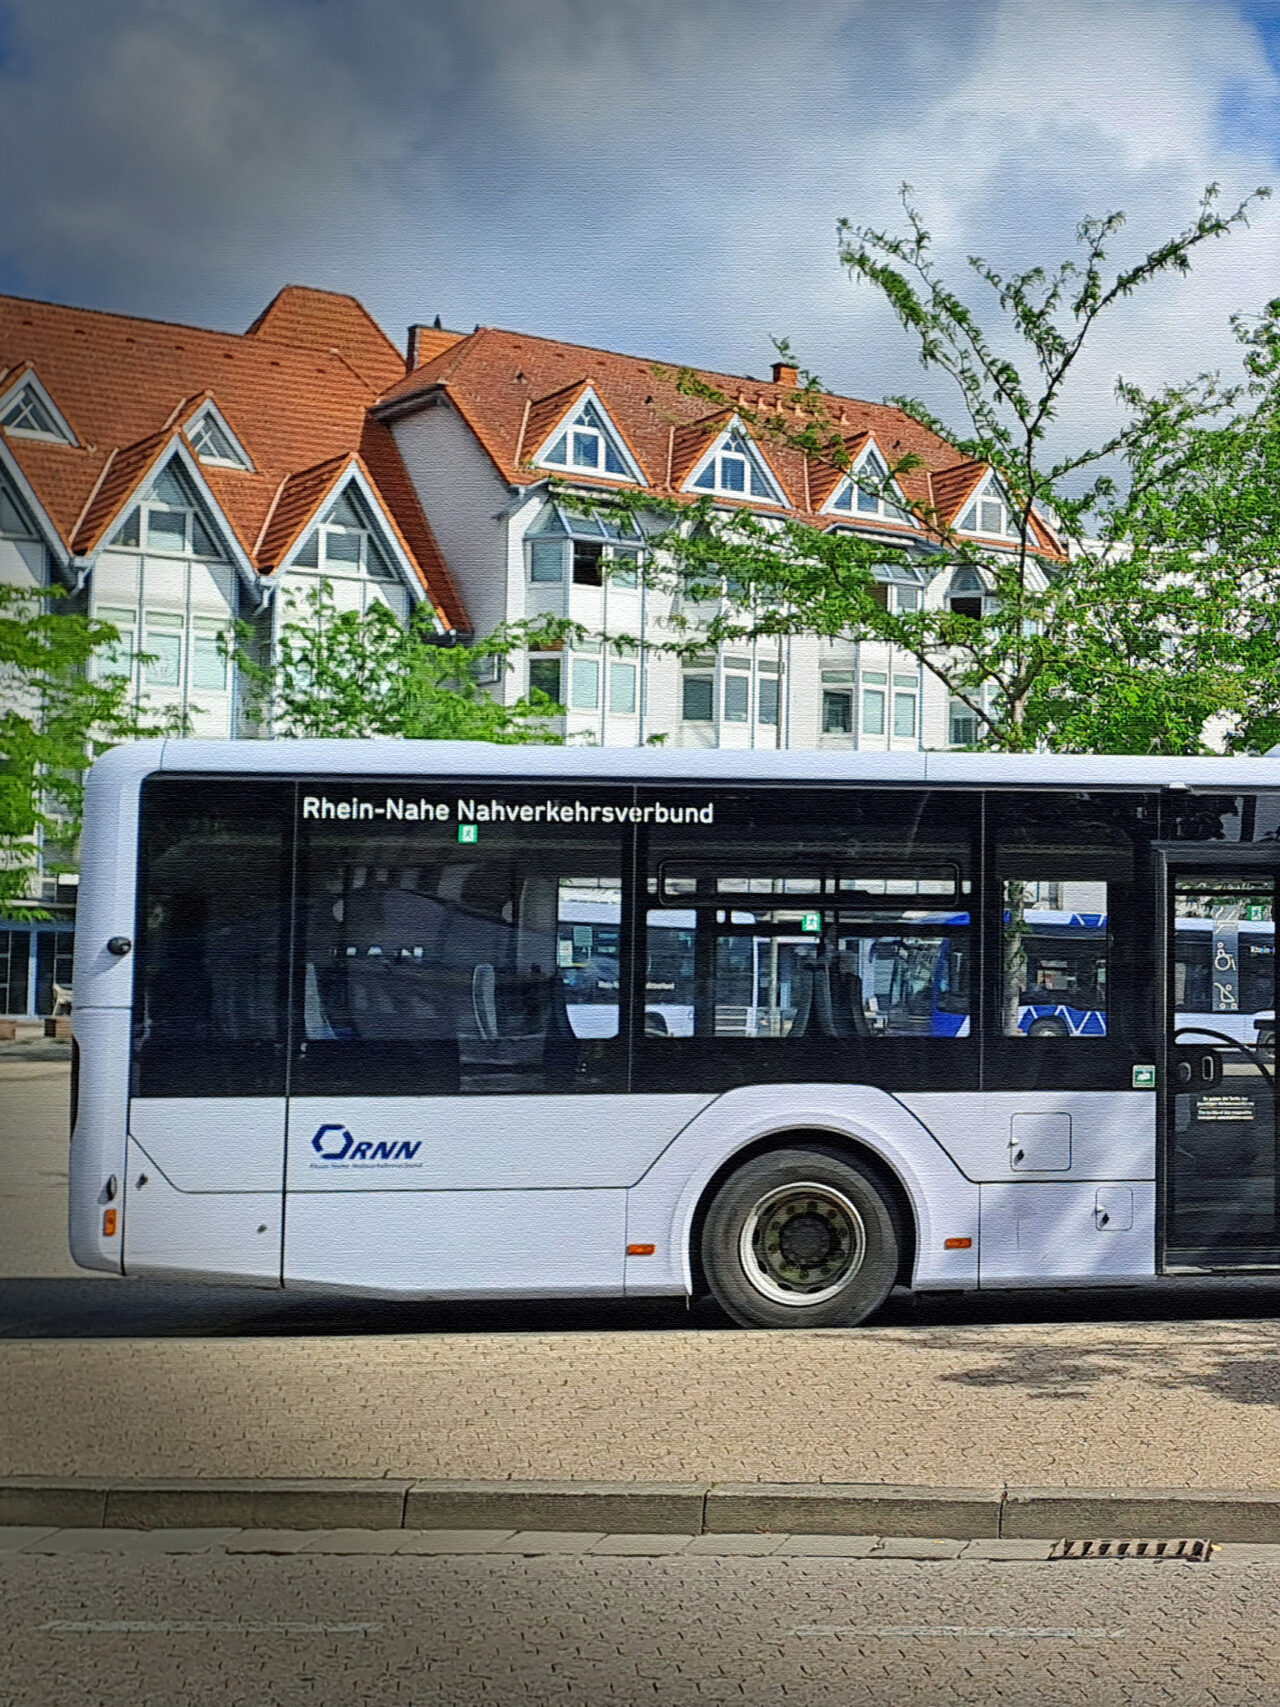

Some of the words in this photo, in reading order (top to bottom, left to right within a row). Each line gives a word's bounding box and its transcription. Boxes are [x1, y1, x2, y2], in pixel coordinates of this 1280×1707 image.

[303, 796, 450, 821] Rhein-Nahe
[457, 799, 714, 824] Nahverkehrsverbund
[349, 1141, 422, 1160] RNN
